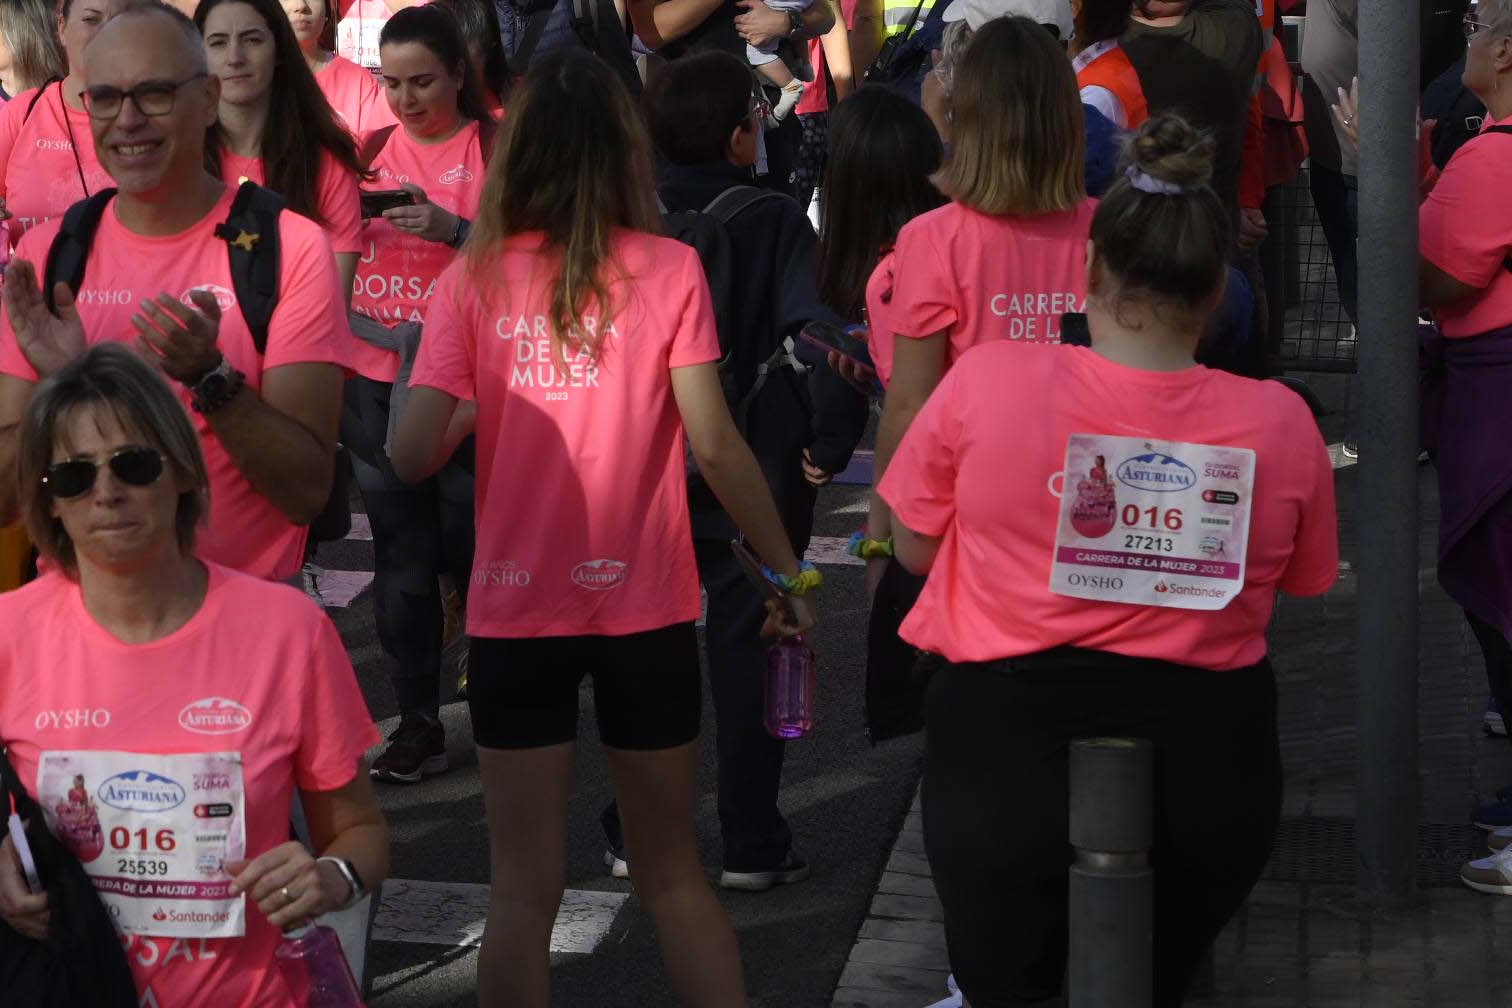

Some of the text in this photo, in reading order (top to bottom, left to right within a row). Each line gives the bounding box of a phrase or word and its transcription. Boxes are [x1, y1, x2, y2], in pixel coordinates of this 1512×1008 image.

[1010, 317, 1061, 340] DE L
[517, 339, 551, 362] DE
[511, 364, 599, 388] MUJER
[545, 392, 568, 400] 2023
[1122, 466, 1189, 486] ASTURIANA
[1204, 469, 1240, 480] SUMA
[1121, 504, 1183, 530] 016
[1125, 535, 1173, 551] 27213
[1076, 553, 1225, 575] CARRERA DE LA MUJER 2023
[1068, 574, 1226, 598] OYSHO Santander
[35, 708, 110, 729] OYSHO
[105, 785, 179, 802] ASTURIANA
[110, 826, 176, 851] 016
[118, 859, 168, 875] 25539
[123, 883, 137, 892] DE
[139, 884, 153, 894] LA
[156, 885, 196, 896] MUJER
[170, 911, 230, 922] Santander
